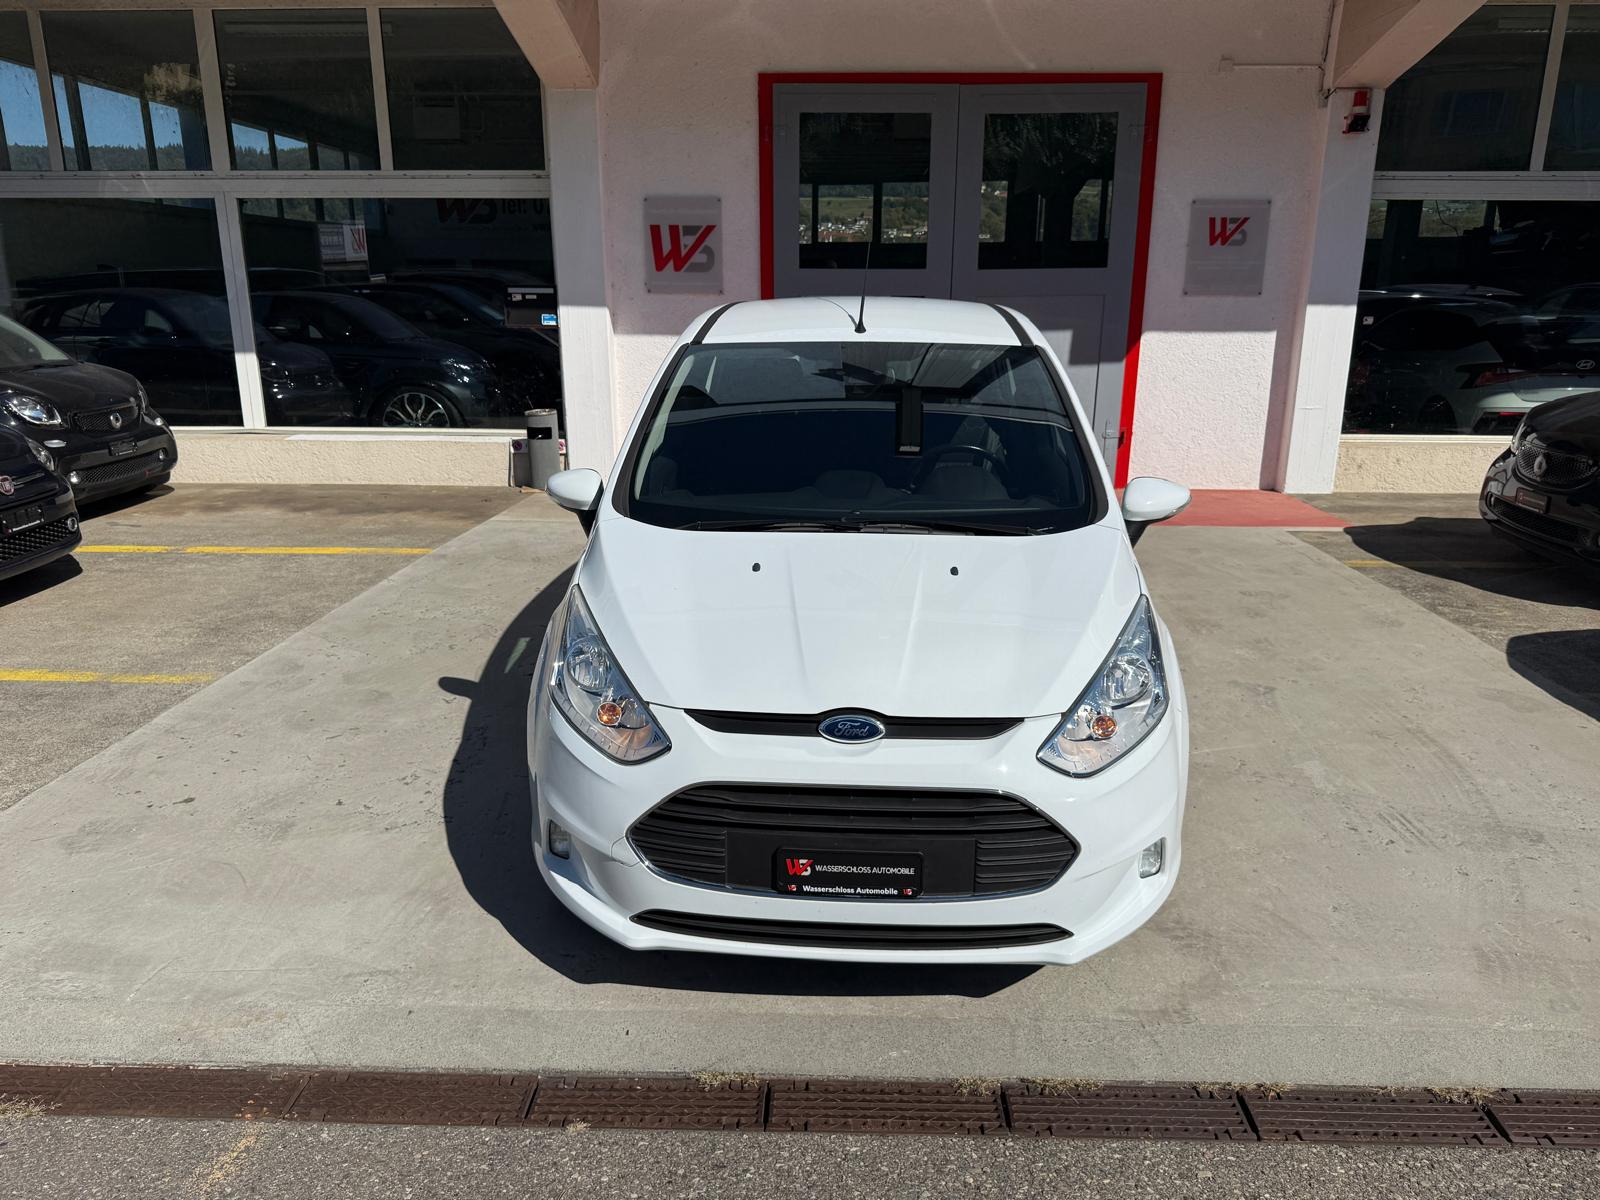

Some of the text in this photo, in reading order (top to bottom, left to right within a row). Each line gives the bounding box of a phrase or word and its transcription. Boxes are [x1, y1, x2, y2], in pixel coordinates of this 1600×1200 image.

[834, 721, 870, 737] Ford
[815, 864, 915, 875] WASSERSCHLOSS AUTOMOBILE
[802, 885, 855, 894] Wasserschloss
[856, 887, 898, 895] Automobile
